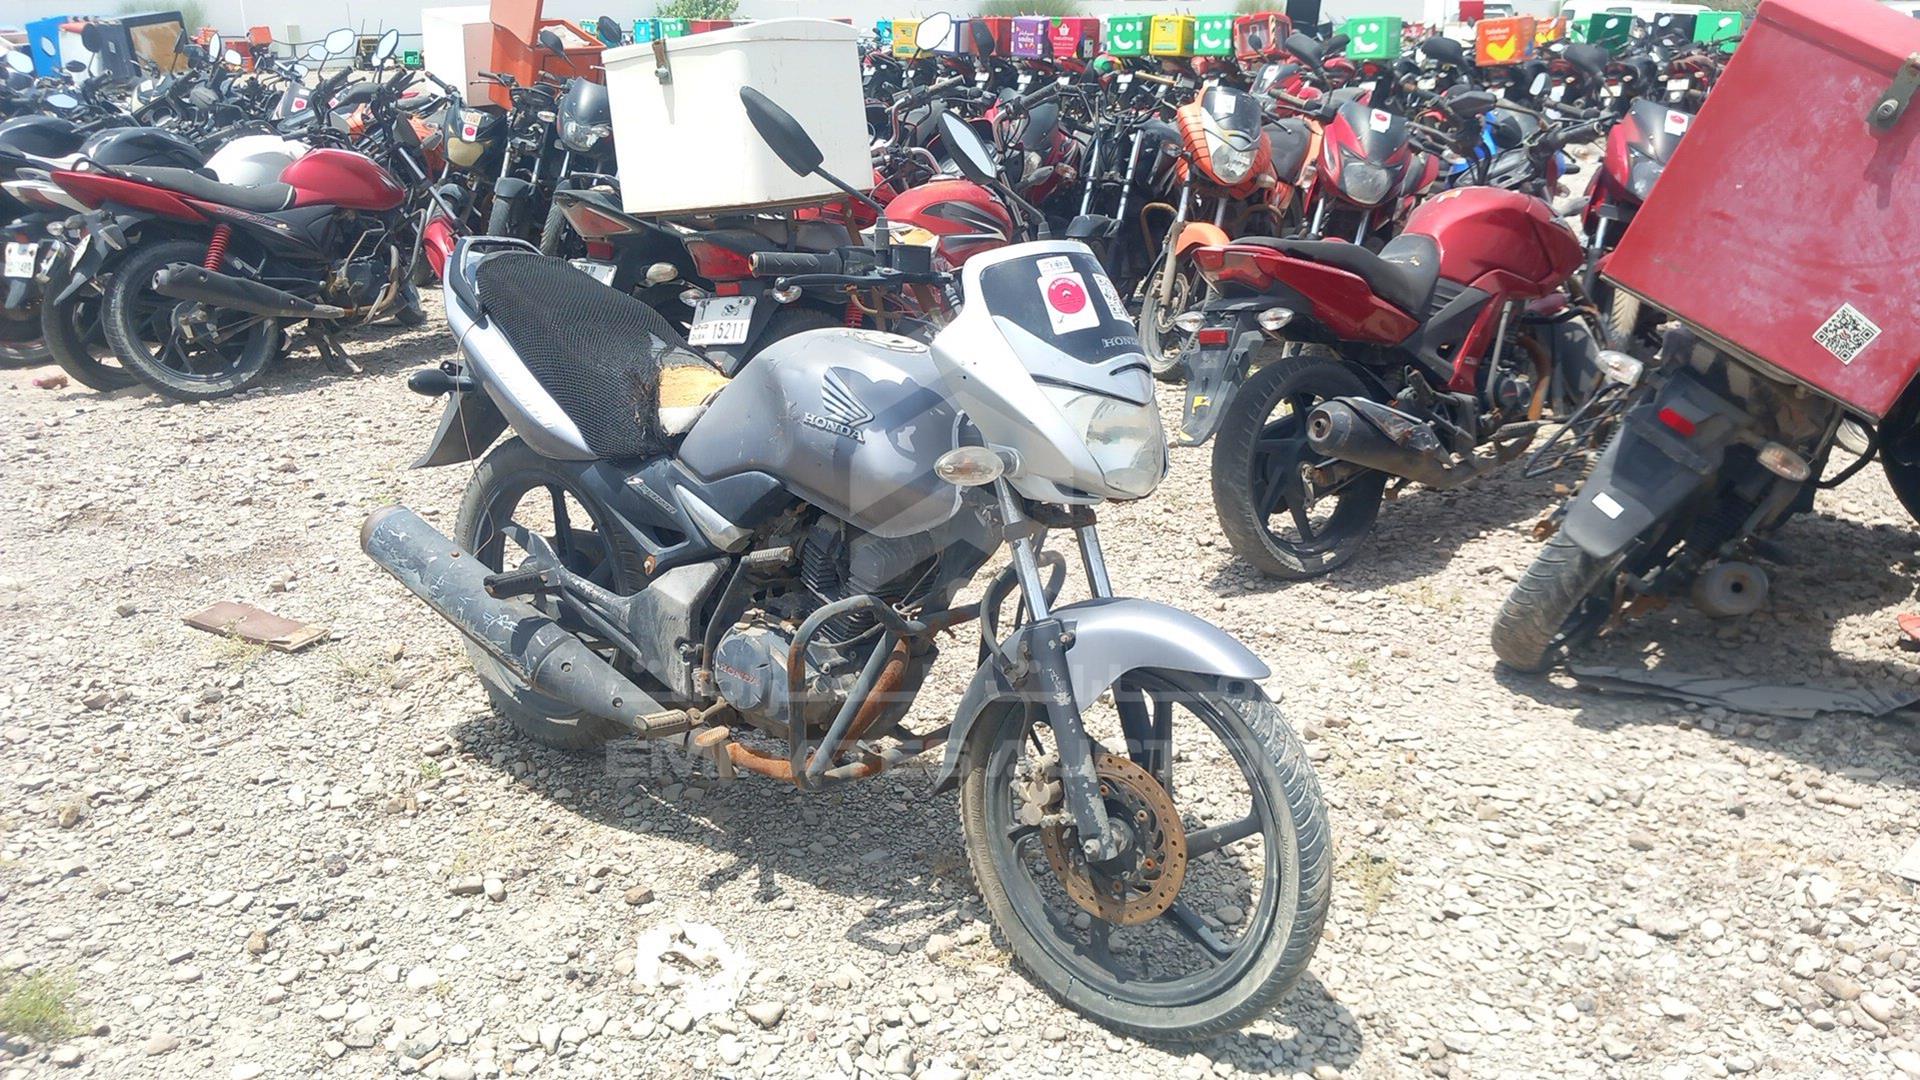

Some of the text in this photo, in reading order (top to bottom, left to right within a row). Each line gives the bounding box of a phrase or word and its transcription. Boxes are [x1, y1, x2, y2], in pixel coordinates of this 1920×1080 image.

[712, 322, 744, 339] 15211
[1101, 335, 1138, 349] HOND
[803, 412, 865, 444] HONDA
[719, 663, 763, 688] HONDA
